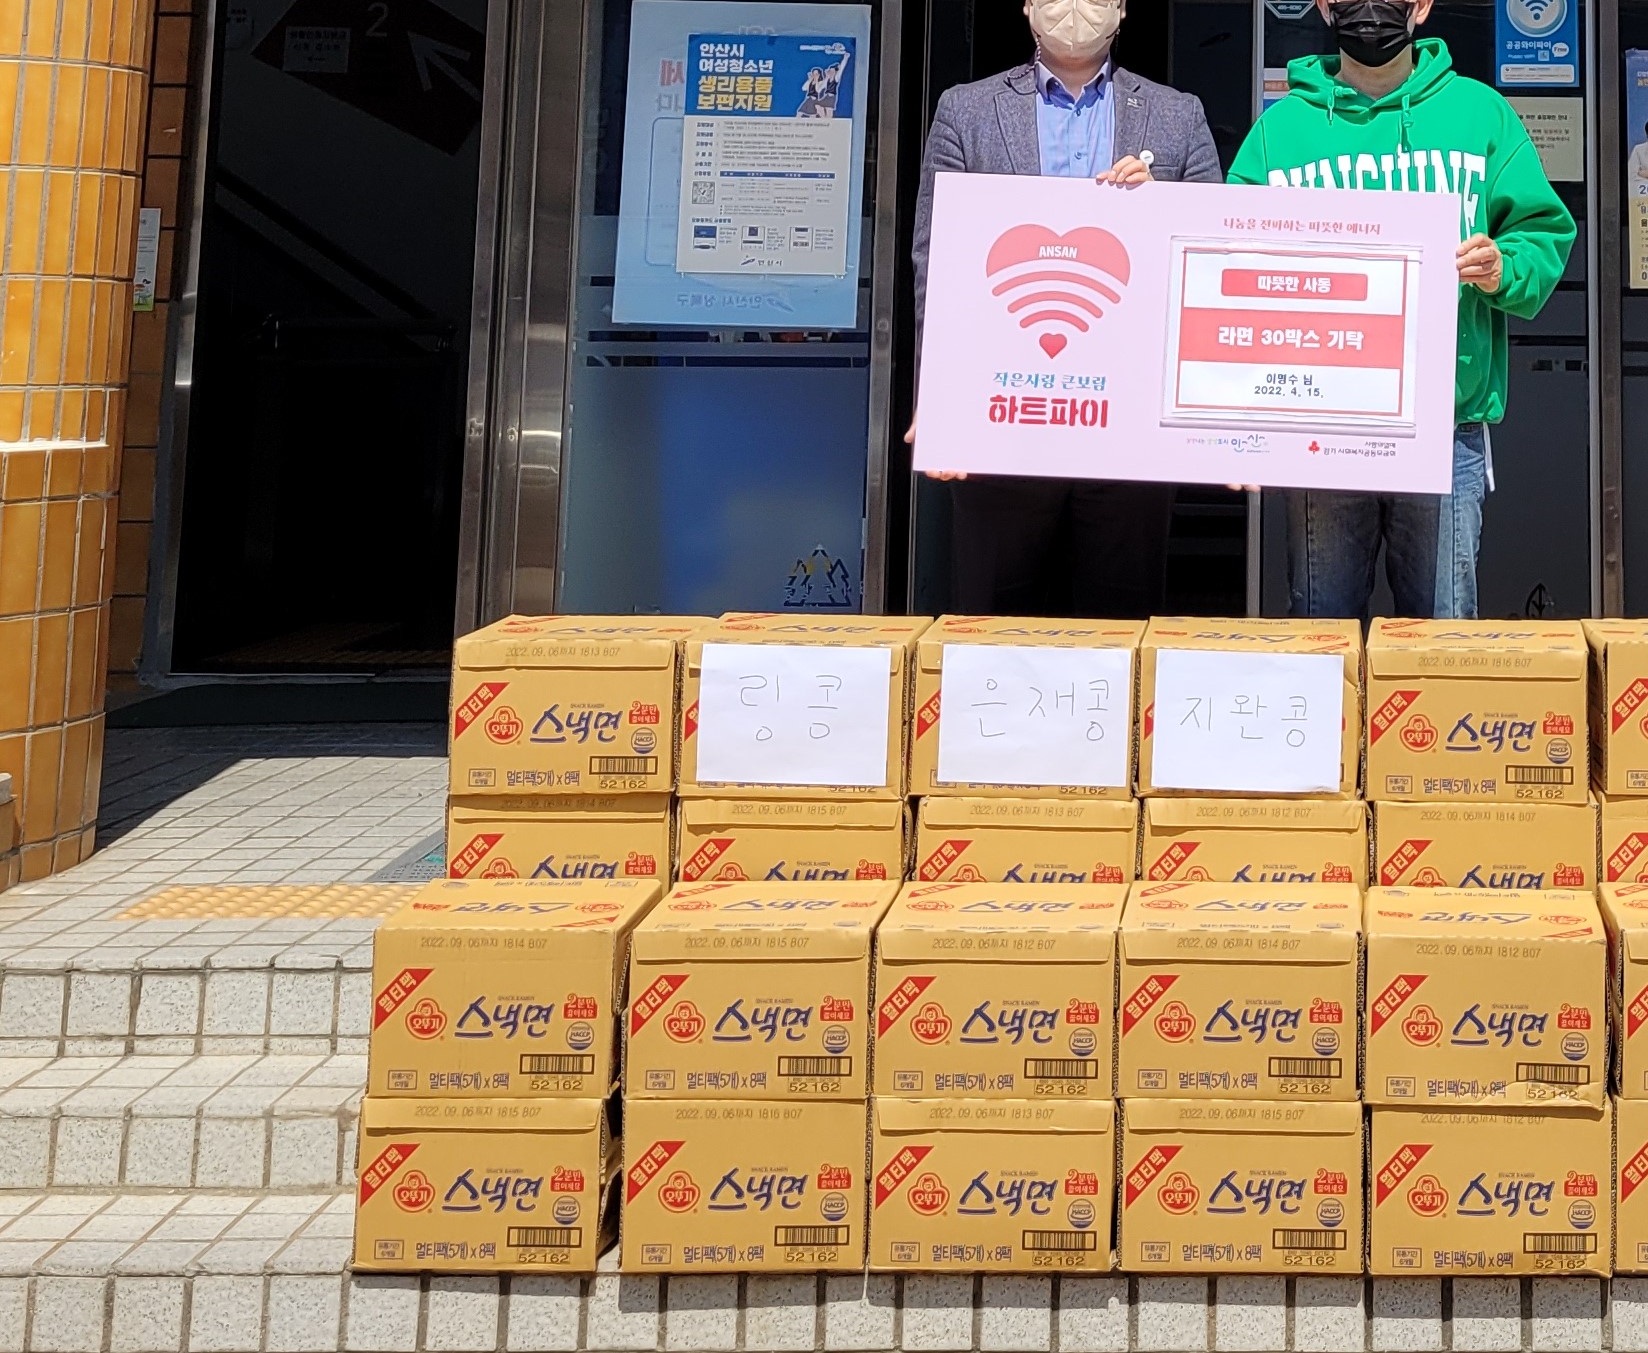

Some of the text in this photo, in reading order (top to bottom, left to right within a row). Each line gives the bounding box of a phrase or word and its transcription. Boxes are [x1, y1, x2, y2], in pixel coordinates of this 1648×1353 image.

[365, 3, 388, 38] 2
[699, 43, 745, 58] 안산시
[1505, 40, 1552, 50] 공공와이파이
[697, 76, 773, 93] 생리용품
[699, 59, 774, 74] 여성청소년
[696, 94, 772, 111] 보편지원
[1223, 218, 1256, 230] 나눔을
[1346, 222, 1380, 235] 에너지
[1039, 245, 1077, 259] ANSAN
[1257, 275, 1331, 294] 따뜻한 사동
[1218, 326, 1364, 351] 라면 30박스 기탁
[993, 371, 1106, 392] 작은사랑 큰보람
[1254, 386, 1324, 398] 2022. 4. 15.
[1266, 373, 1313, 386] 이명수 님
[989, 395, 1108, 428] 하트파이
[1180, 694, 1308, 747] 지완콩
[1372, 693, 1408, 730] 멀티팩
[1612, 682, 1647, 722] 멀티팩
[530, 703, 623, 744] 스낵면
[1407, 732, 1431, 743] 오뚜기
[1445, 712, 1537, 753] 스낵면
[455, 994, 557, 1040] 스낵면
[634, 978, 673, 1019] 멀티팩
[881, 979, 920, 1021] 멀티팩
[1125, 978, 1163, 1019] 멀티팩
[1370, 980, 1409, 1022] 멀티팩
[670, 1021, 697, 1033] 오뚜기
[712, 997, 813, 1043] 스낵면
[918, 1022, 944, 1034] 오뚜기
[959, 999, 1060, 1045] 스낵면
[1162, 1021, 1188, 1033] 오뚜기
[1203, 999, 1303, 1044] 스낵면
[1450, 1002, 1550, 1048] 스낵면
[363, 1147, 403, 1189] 멀티팩
[878, 1149, 917, 1191] 멀티팩
[1128, 1148, 1167, 1190] 멀티팩
[442, 1167, 544, 1213] 스낵면
[708, 1163, 810, 1212] 스낵면
[915, 1193, 942, 1205] 오뚜기
[957, 1170, 1058, 1216] 스낵면
[1165, 1192, 1192, 1204] 오뚜기
[1207, 1169, 1307, 1215] 스낵면
[1456, 1171, 1557, 1218] 스낵면
